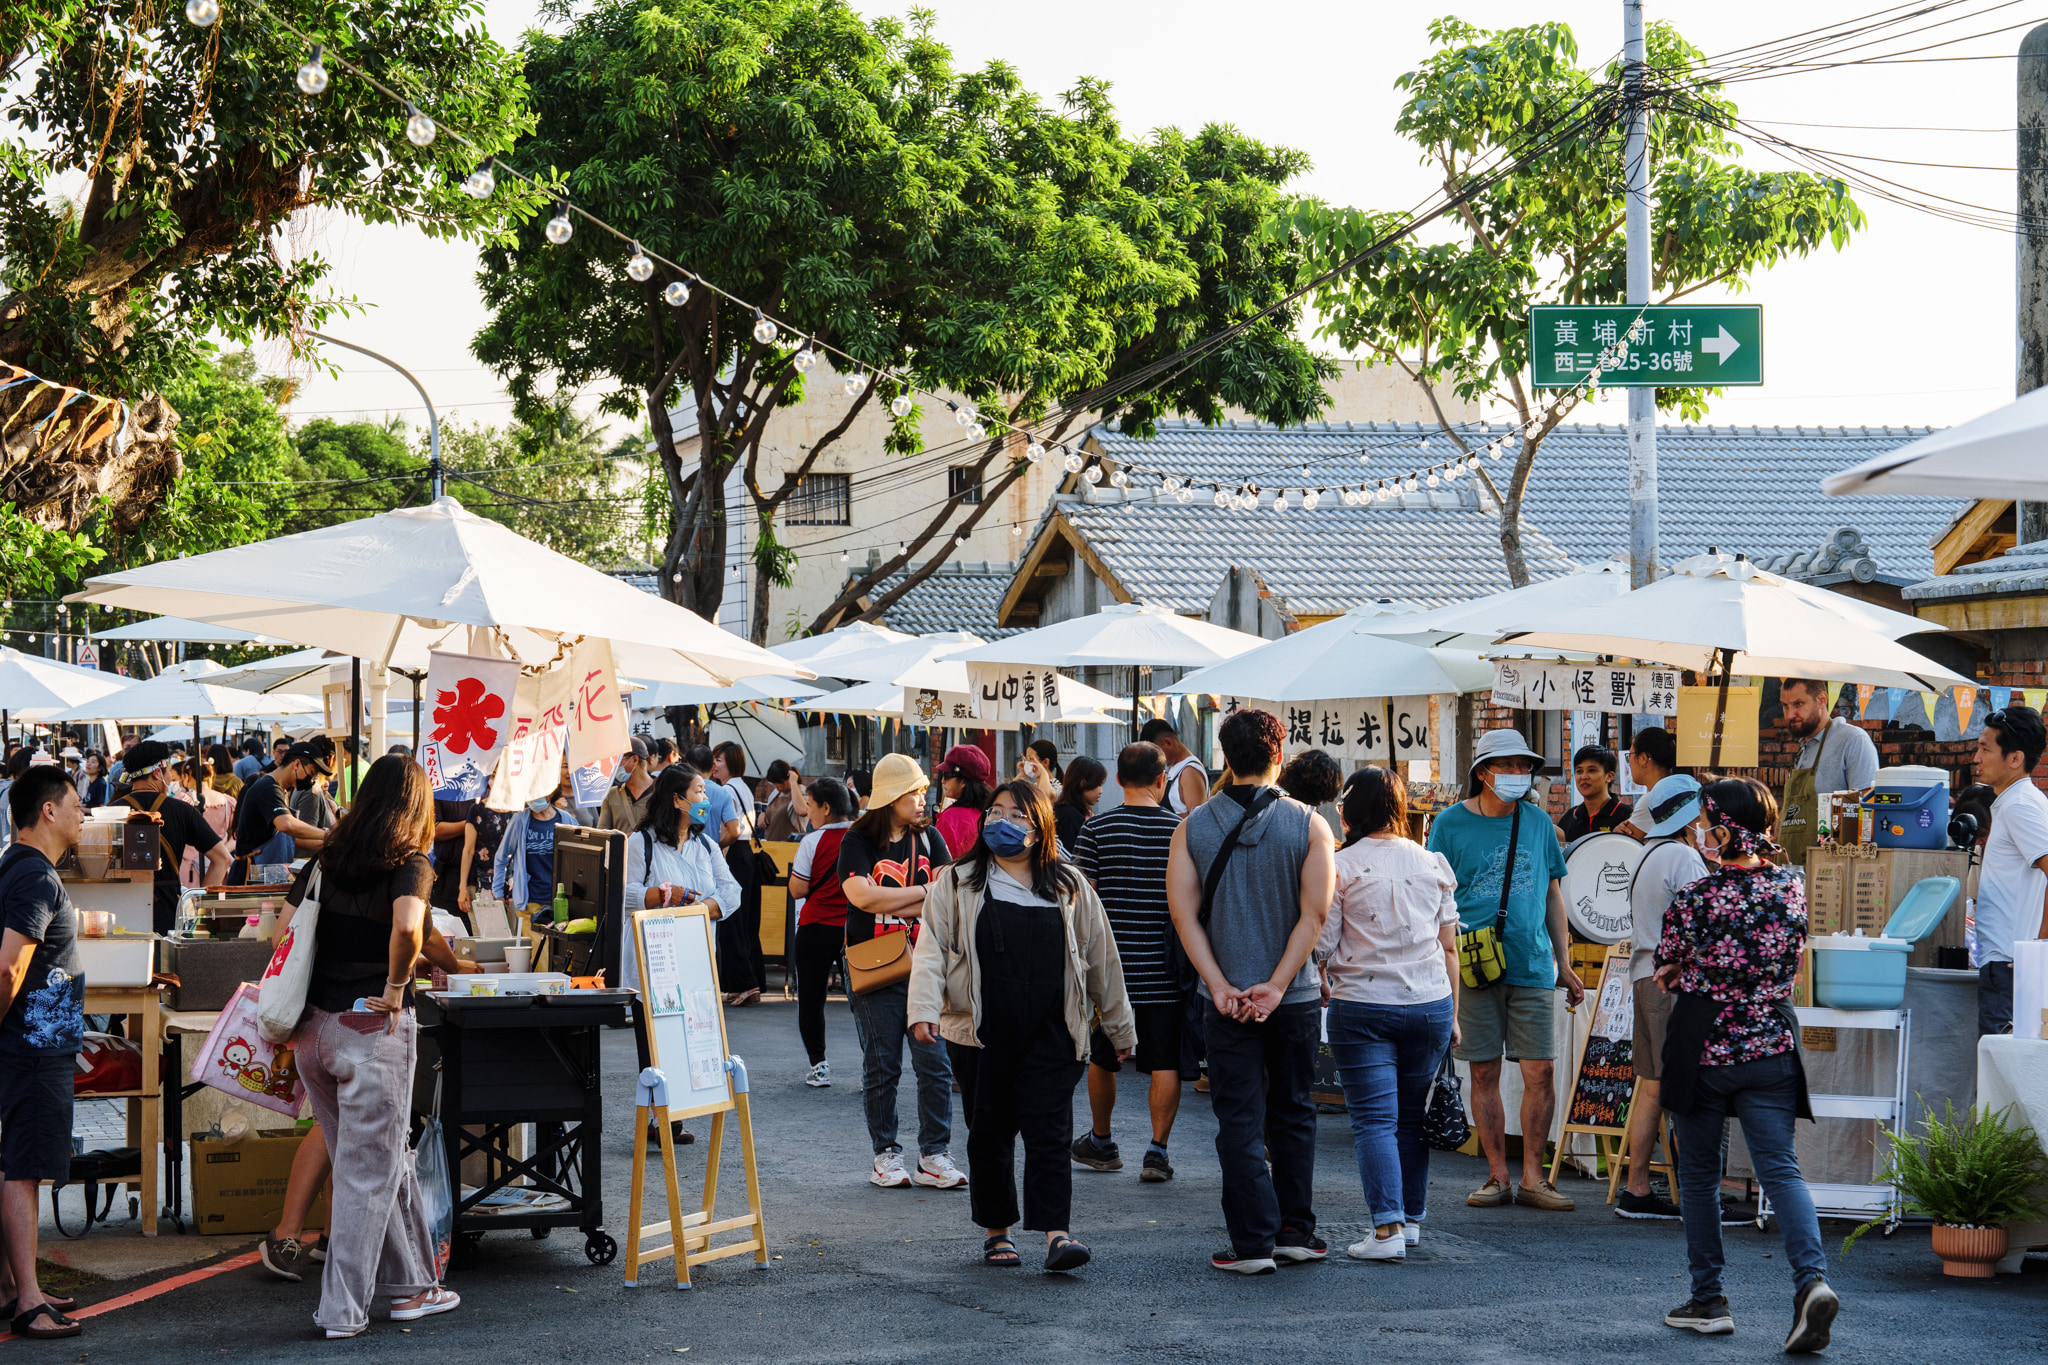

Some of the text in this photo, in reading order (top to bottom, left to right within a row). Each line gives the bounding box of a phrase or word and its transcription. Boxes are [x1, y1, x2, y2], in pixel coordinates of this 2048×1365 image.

[1554, 319, 1693, 347] 黃埔新村
[1554, 351, 1693, 373] 西三巷25-36號
[1532, 668, 1635, 707] 小怪獸
[1651, 671, 1675, 689] 德國
[1649, 691, 1675, 709] 美食
[426, 747, 440, 787] つめたい
